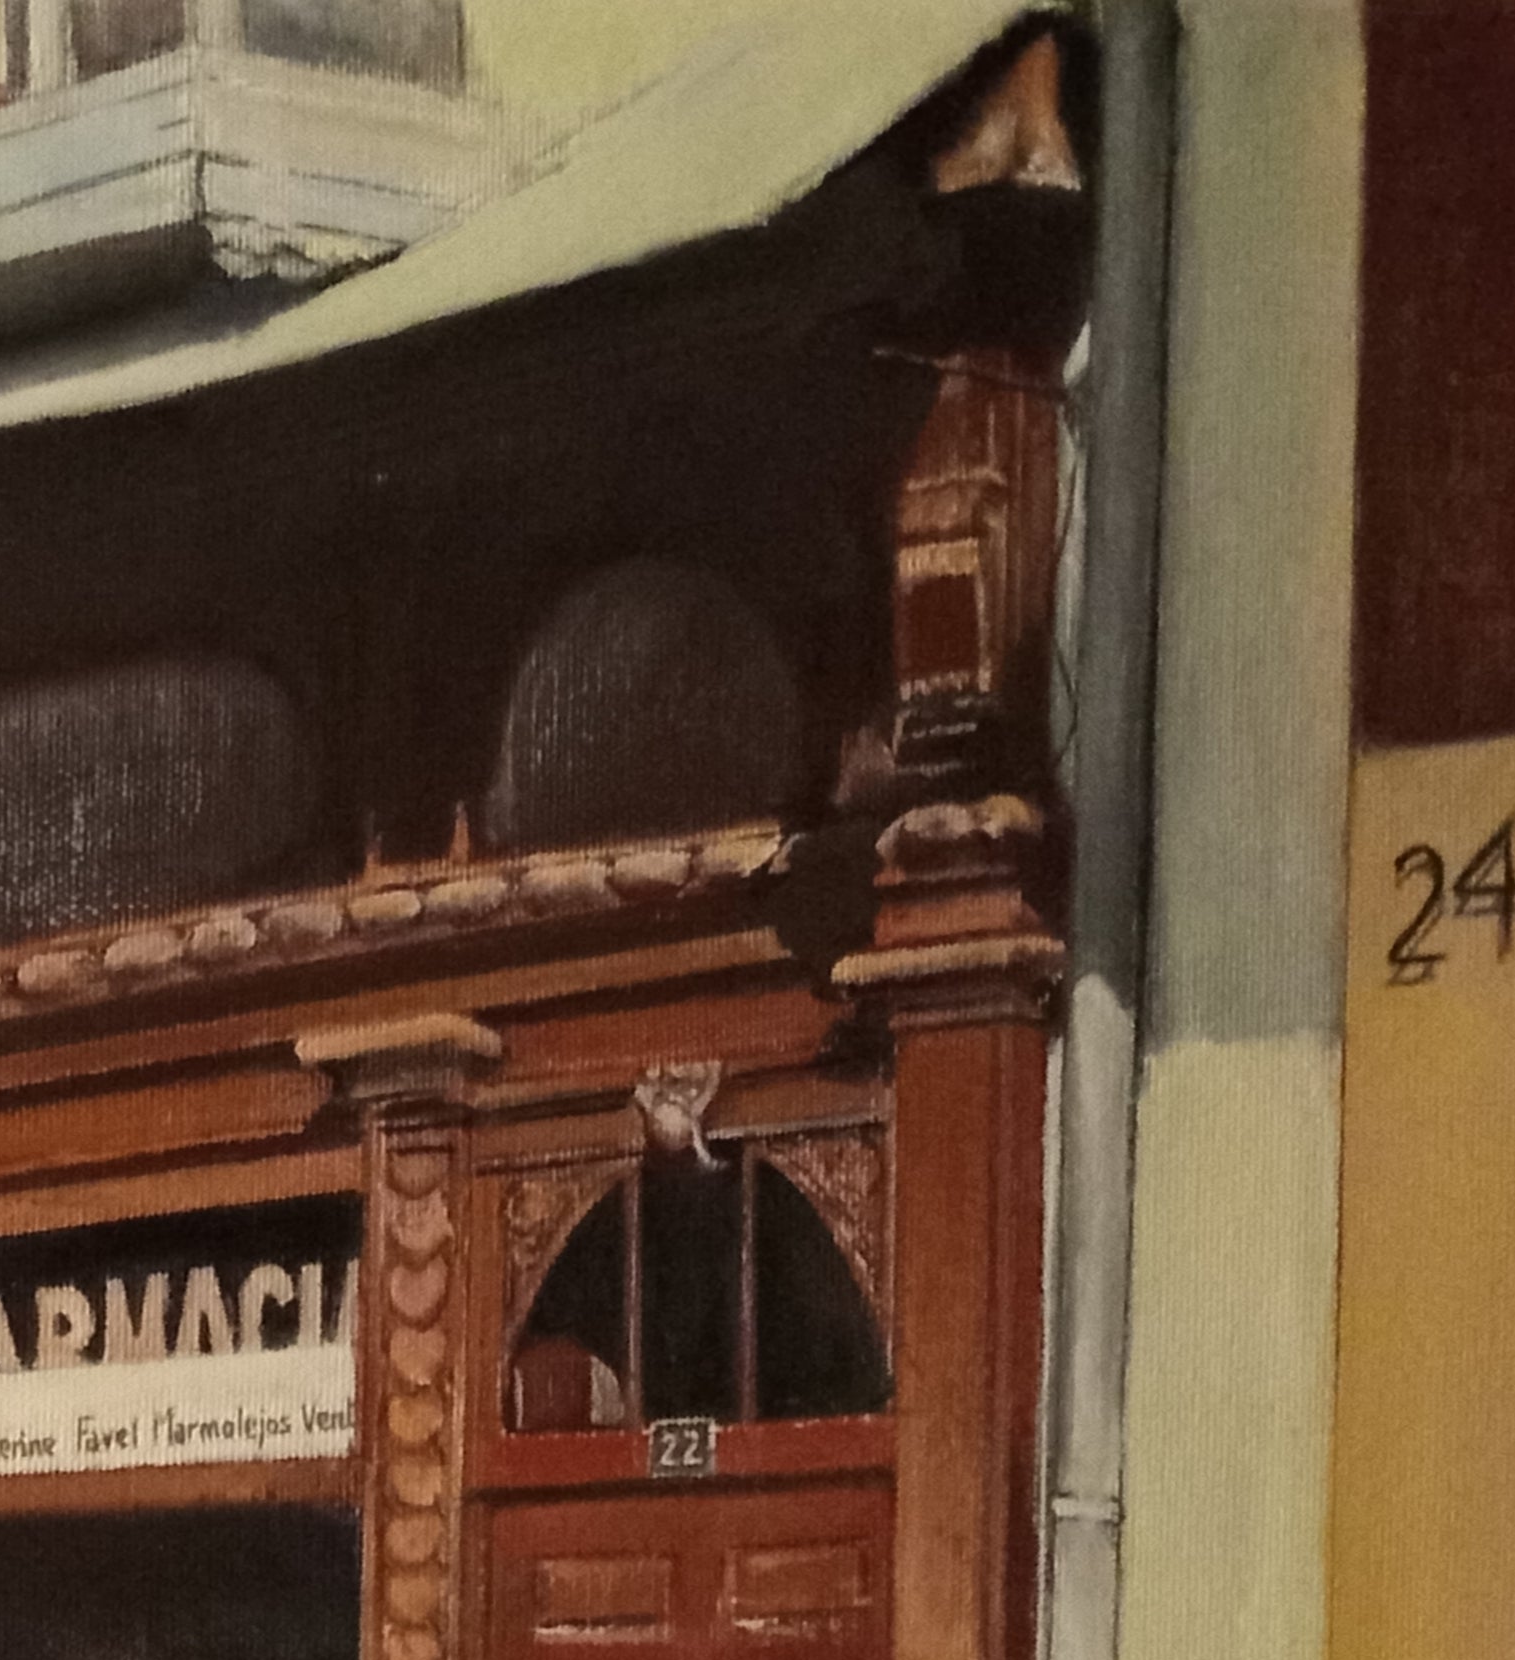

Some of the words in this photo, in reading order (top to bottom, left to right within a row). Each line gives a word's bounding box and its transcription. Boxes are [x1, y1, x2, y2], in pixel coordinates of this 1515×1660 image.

[1386, 812, 1515, 986] 24
[76, 1414, 139, 1453] Favel
[153, 1405, 292, 1449] Marmolejos
[658, 1429, 704, 1467] 22
